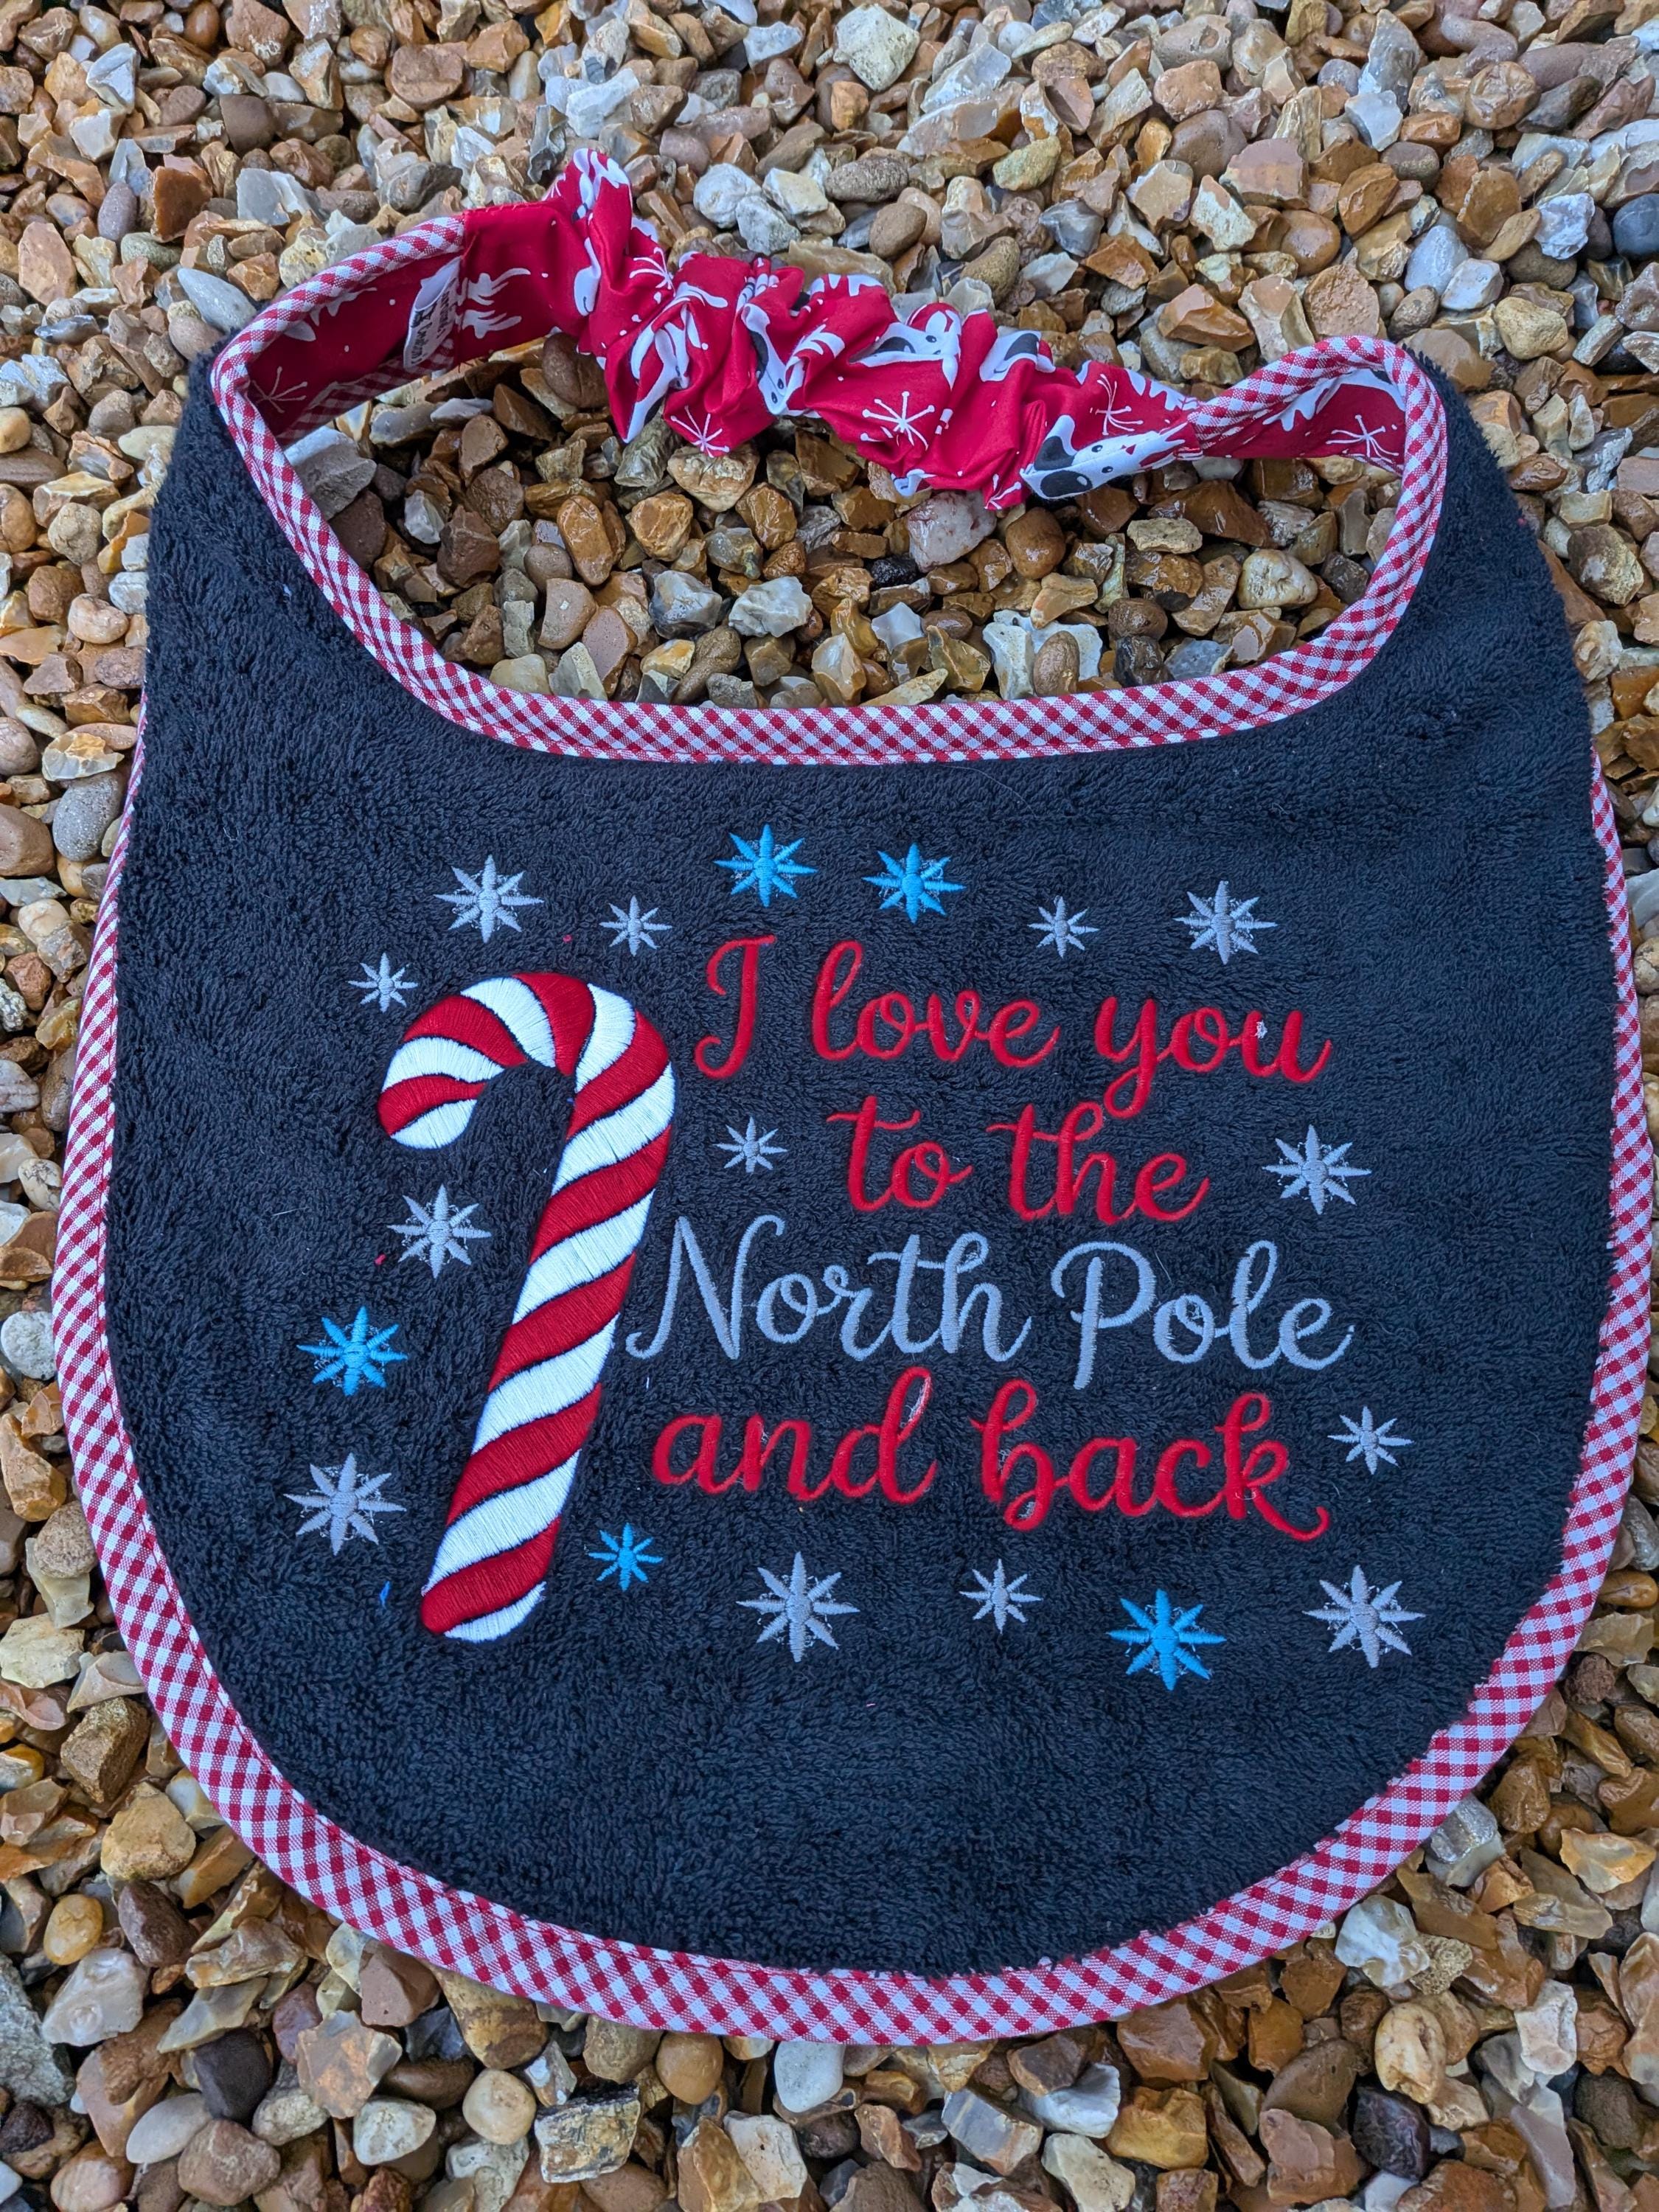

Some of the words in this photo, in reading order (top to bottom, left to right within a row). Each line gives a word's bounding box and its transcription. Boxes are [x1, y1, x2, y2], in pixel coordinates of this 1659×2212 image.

[695, 934, 775, 1078] I
[812, 940, 1060, 1066] love
[1094, 997, 1332, 1118] you
[827, 1095, 972, 1211] to
[987, 1102, 1209, 1225] the
[625, 1214, 1032, 1362] North
[1051, 1240, 1355, 1390] Pole
[653, 1366, 936, 1503] and
[972, 1379, 1329, 1541] back
